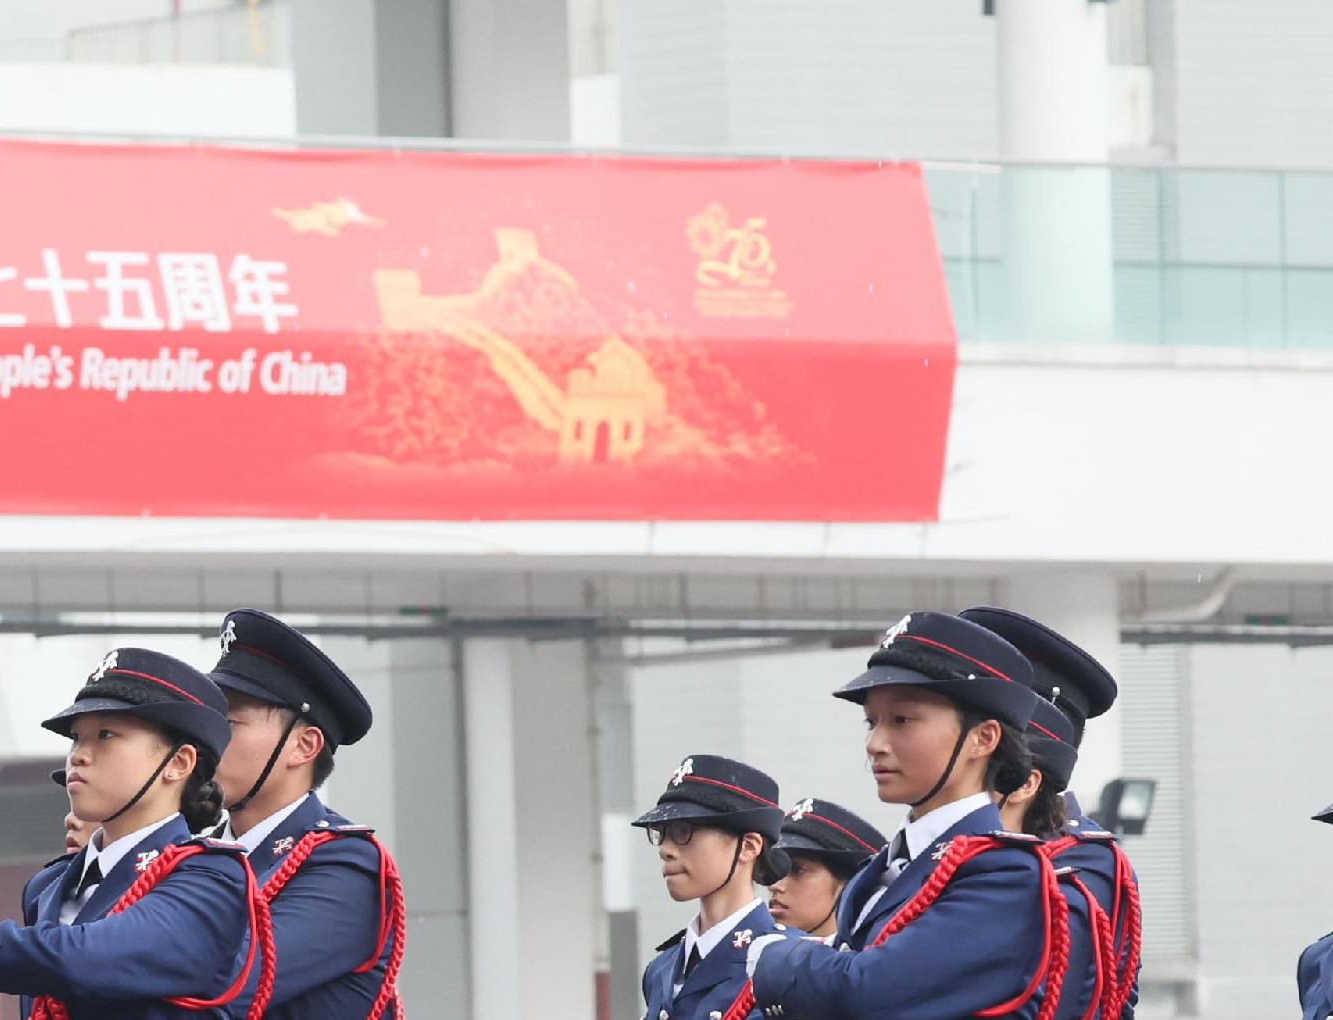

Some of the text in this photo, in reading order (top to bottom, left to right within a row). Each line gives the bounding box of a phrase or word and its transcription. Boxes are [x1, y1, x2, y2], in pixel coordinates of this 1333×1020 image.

[80, 347, 214, 400] Republic
[218, 348, 257, 393] of
[259, 350, 347, 396] China
